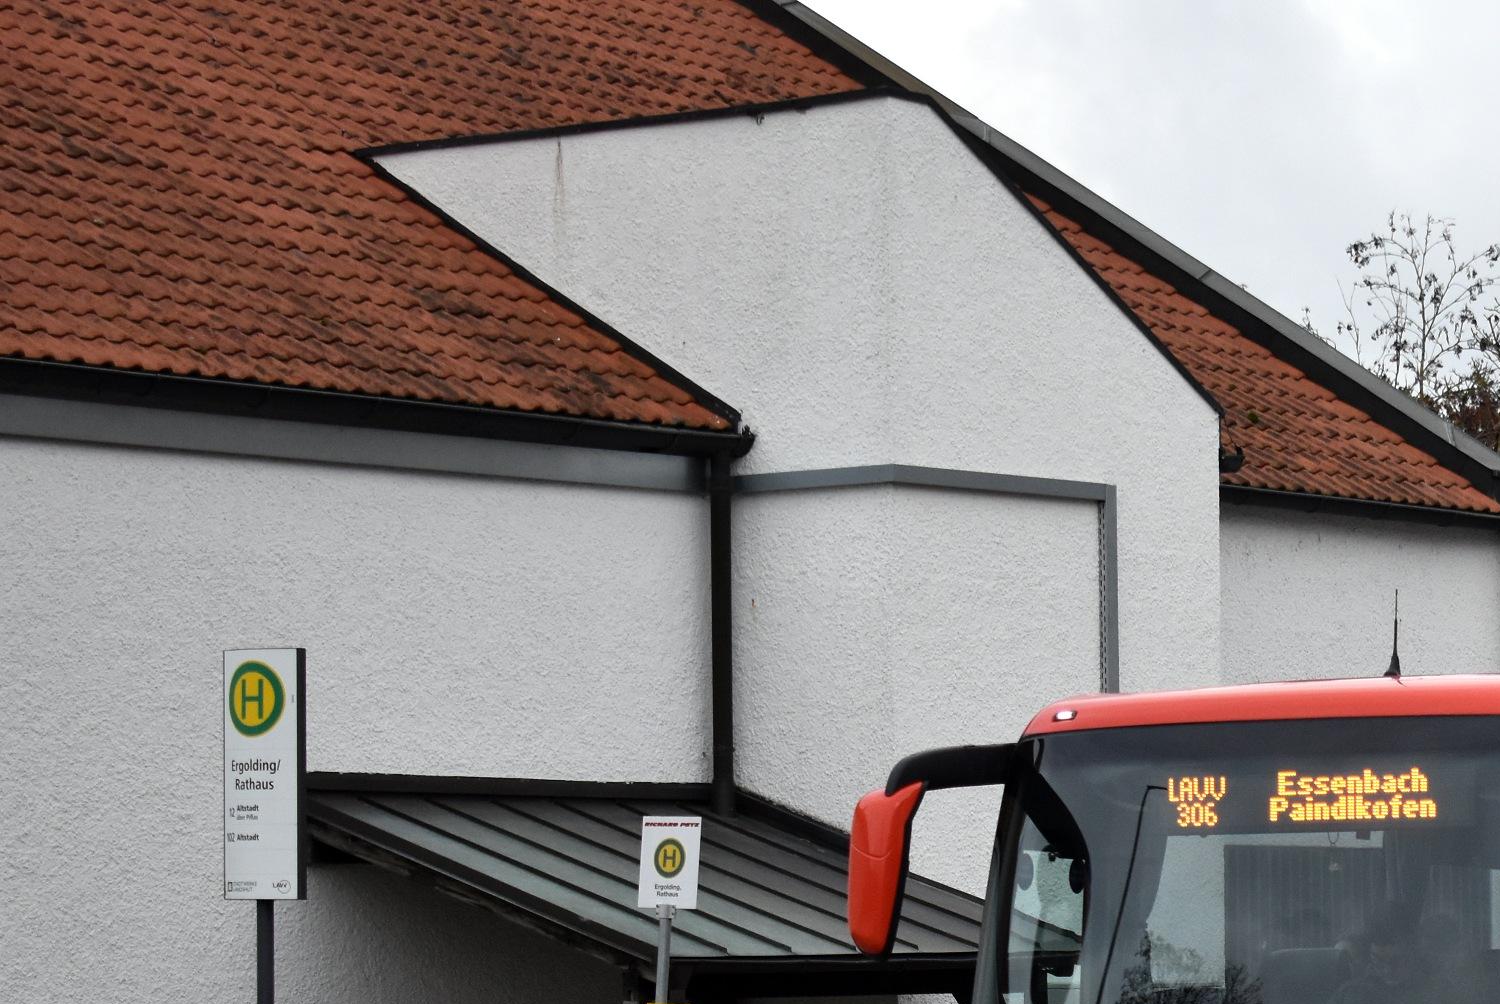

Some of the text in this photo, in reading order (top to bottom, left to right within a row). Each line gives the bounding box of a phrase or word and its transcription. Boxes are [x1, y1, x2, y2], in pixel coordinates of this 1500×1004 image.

[242, 679, 263, 719] H
[231, 759, 281, 774] Ergolding/
[235, 778, 274, 790] Rathaus
[1168, 776, 1226, 802] LAVV
[1277, 767, 1428, 796] Essenbach
[1177, 802, 1218, 827] 306
[1269, 794, 1437, 822] Paindlkofen
[237, 833, 259, 841] Altstadt
[663, 849, 676, 867] H
